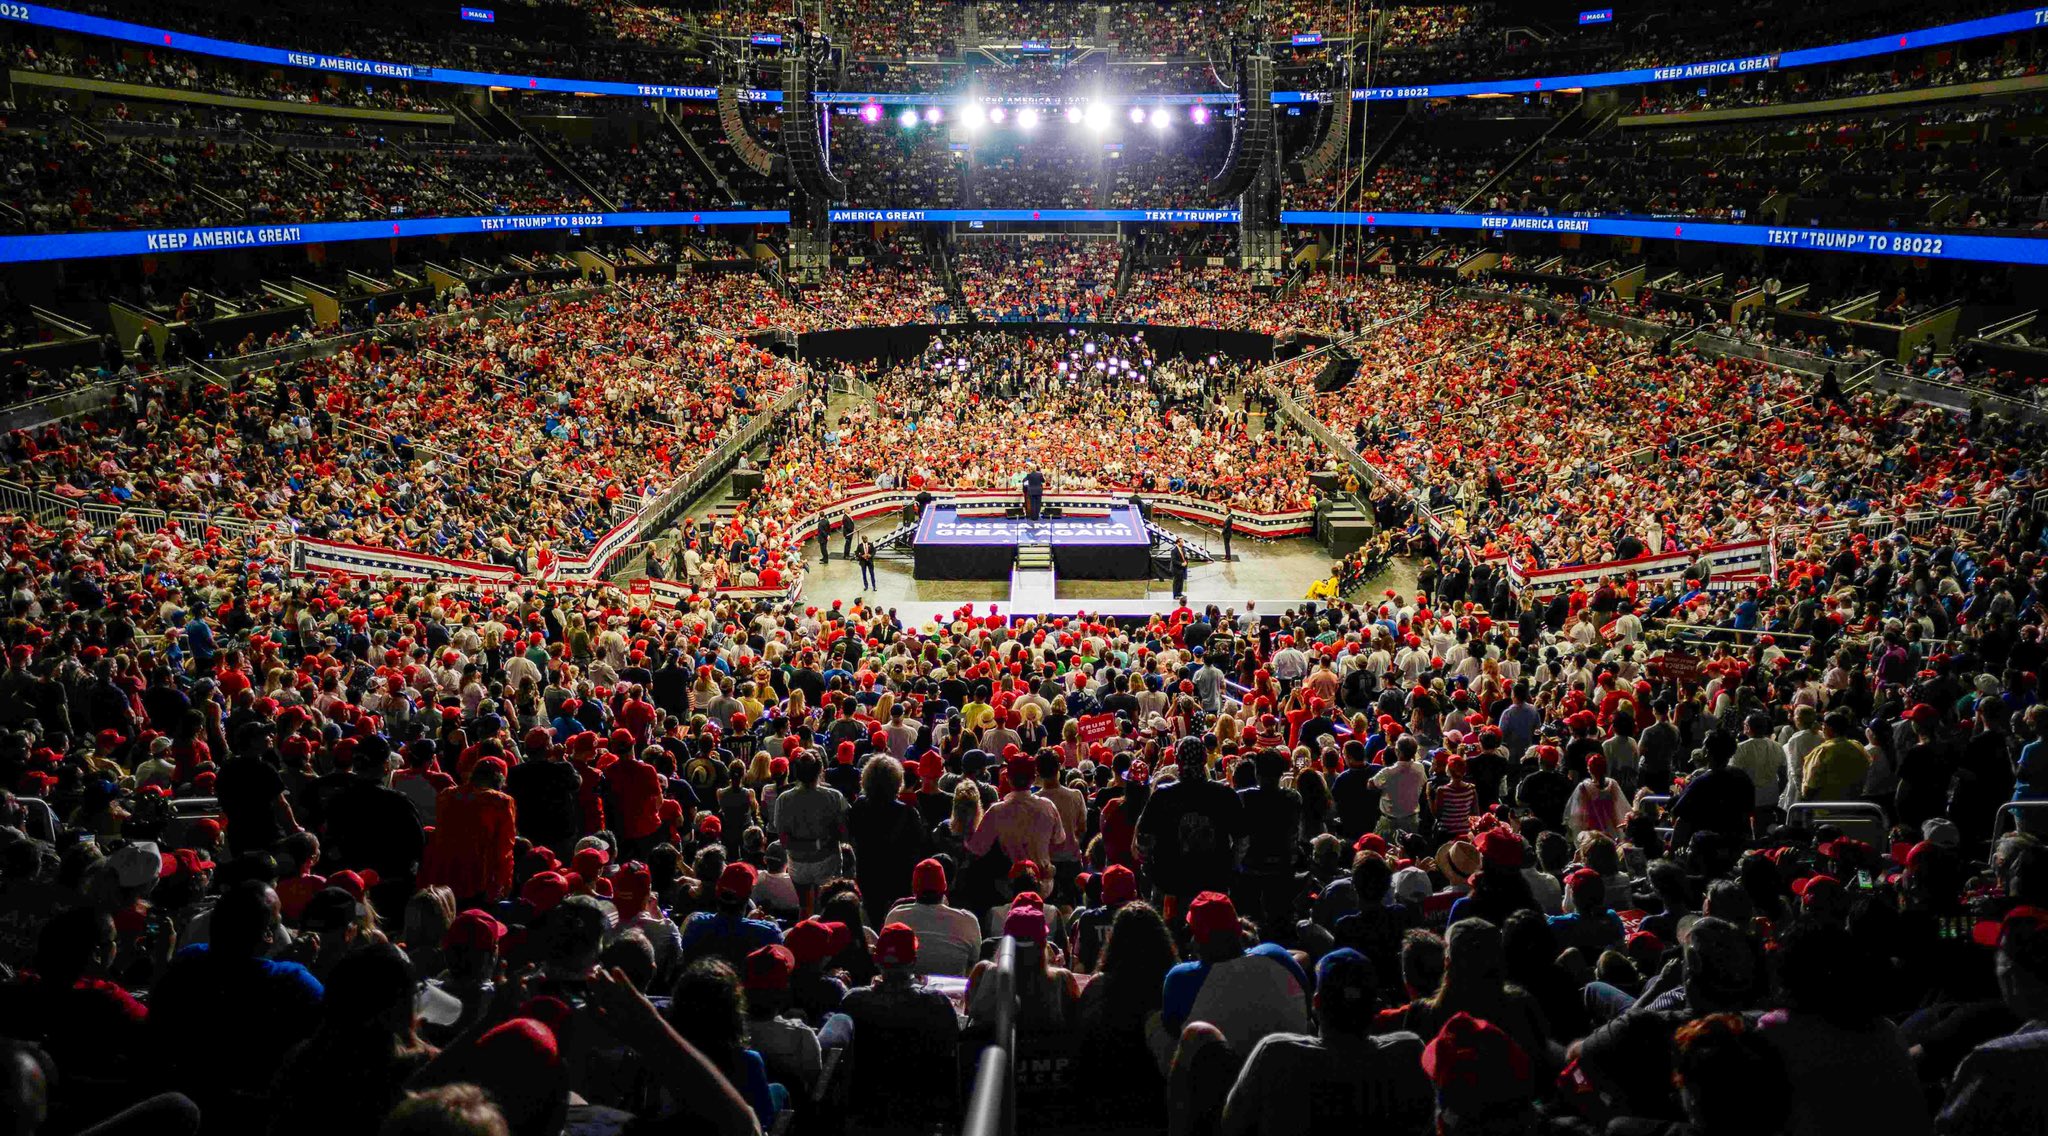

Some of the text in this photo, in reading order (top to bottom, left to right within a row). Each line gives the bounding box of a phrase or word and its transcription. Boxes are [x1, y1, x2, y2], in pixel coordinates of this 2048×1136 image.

[0, 3, 29, 19] 022
[469, 11, 487, 19] MAGA
[1587, 12, 1605, 20] MAGA
[288, 53, 316, 67] KEEP
[319, 57, 371, 73] AMERICA
[374, 64, 412, 78] GREAT!
[1654, 68, 1683, 80] KEEP
[1685, 62, 1735, 77] AMERICA
[638, 86, 716, 97] TEXT "TRUMP"
[1397, 88, 1429, 96] 88022
[834, 211, 924, 220] AMERICA GREAT!
[1146, 211, 1173, 220] TEXT
[1176, 212, 1228, 221] "TRUMP"
[481, 216, 603, 229] TEXT "TRUMP" TO 88022
[1481, 217, 1589, 232] KEEP AMERICA GREAT!
[148, 228, 300, 249] KEEP AMERICA GREAT!
[1768, 230, 1943, 254] TEXT "TRUMP" TO 88022
[936, 522, 1130, 530] MAKE AMERICA
[935, 529, 1132, 538] GREAT AGAIN!
[1080, 720, 1112, 731] TRUMP
[1087, 726, 1106, 735] 2020
